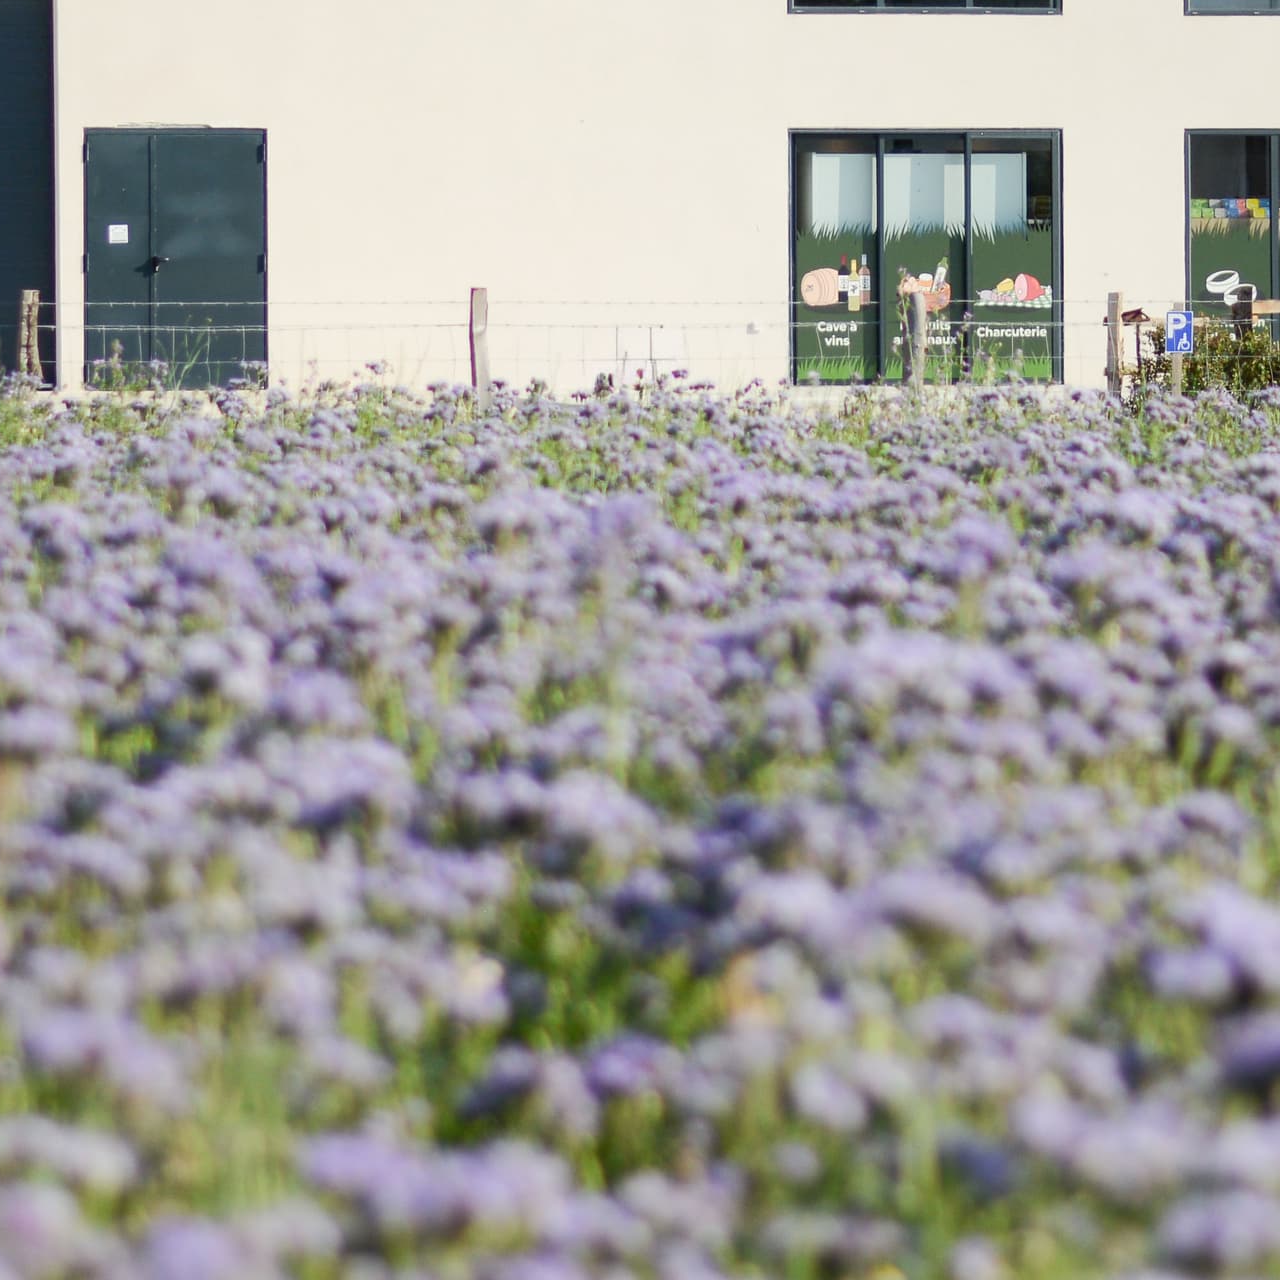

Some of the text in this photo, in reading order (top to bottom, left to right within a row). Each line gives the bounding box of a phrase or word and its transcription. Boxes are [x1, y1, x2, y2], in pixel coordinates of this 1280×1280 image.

[817, 320, 858, 332] Cave à
[976, 325, 1048, 338] Charcuterie
[1167, 313, 1187, 339] P
[824, 334, 851, 347] vins
